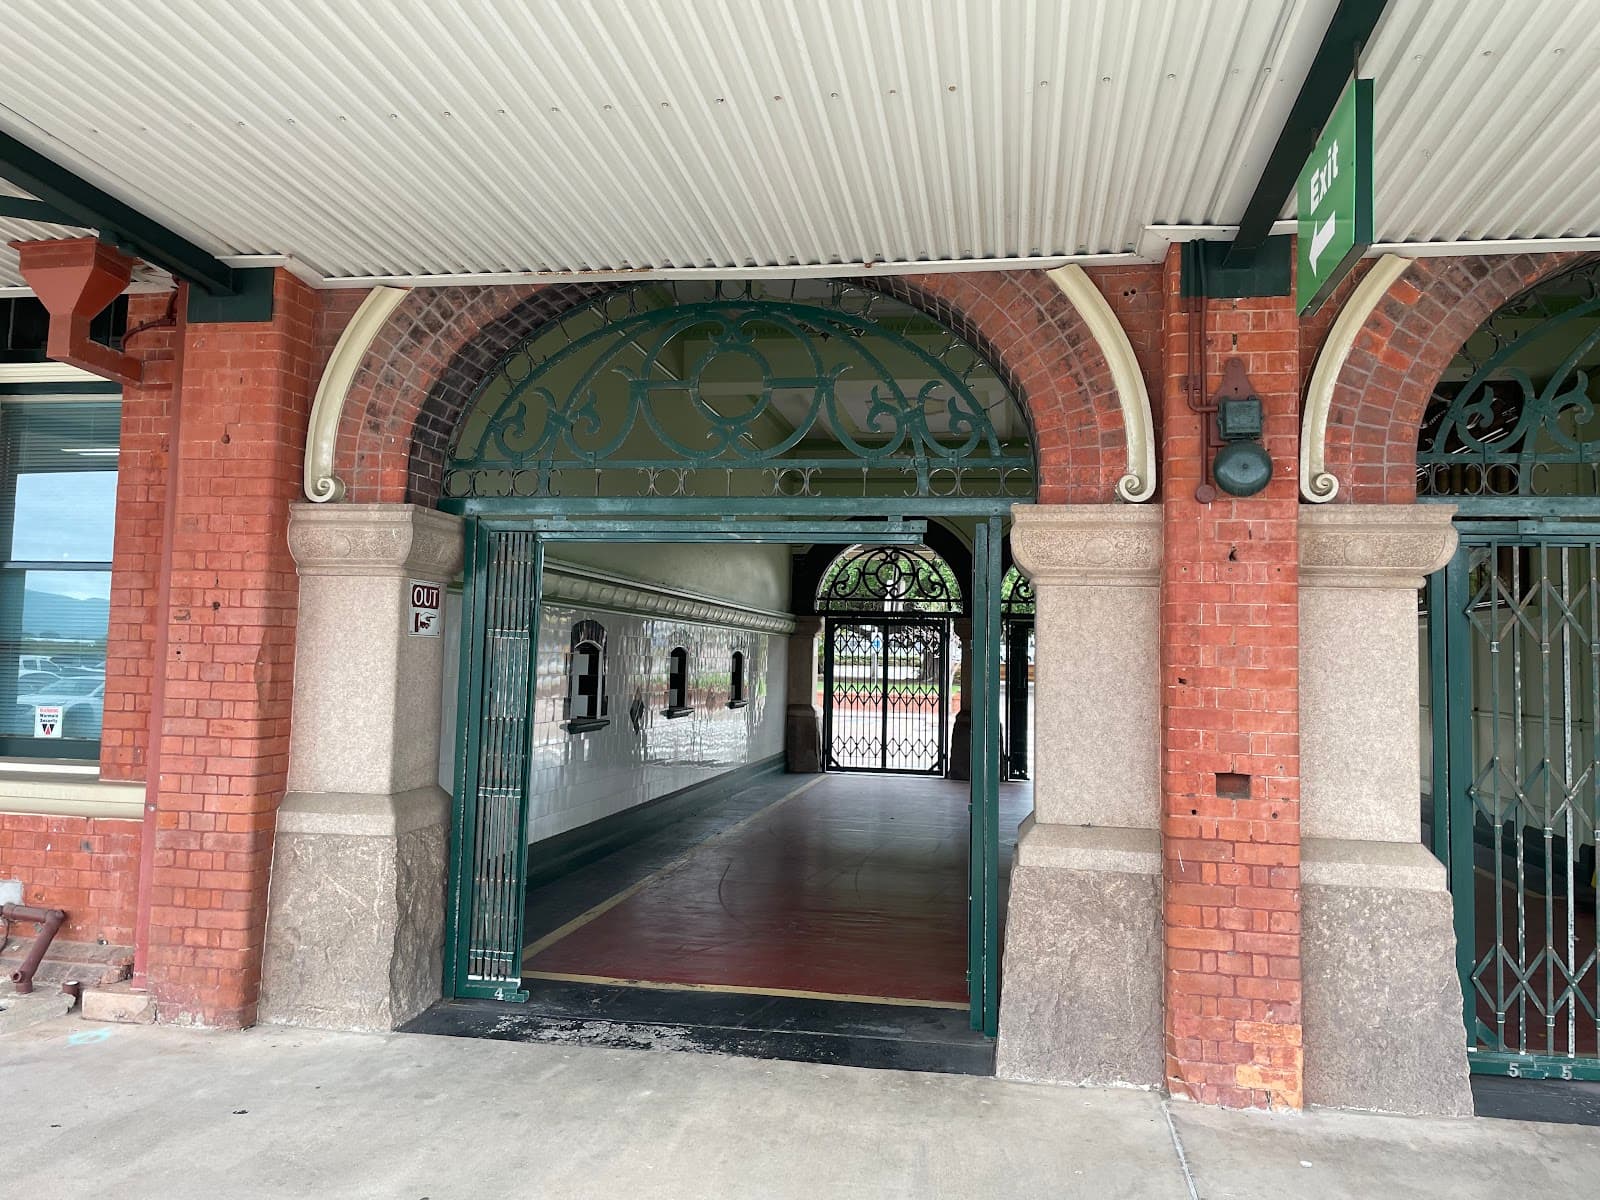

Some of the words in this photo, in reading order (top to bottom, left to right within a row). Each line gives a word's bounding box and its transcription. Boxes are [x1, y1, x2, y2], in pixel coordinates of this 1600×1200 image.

[1310, 139, 1339, 217] Exit
[413, 586, 438, 607] OUT
[494, 987, 505, 1001] 4
[1508, 1063, 1520, 1078] 5
[1561, 1065, 1573, 1081] 5
